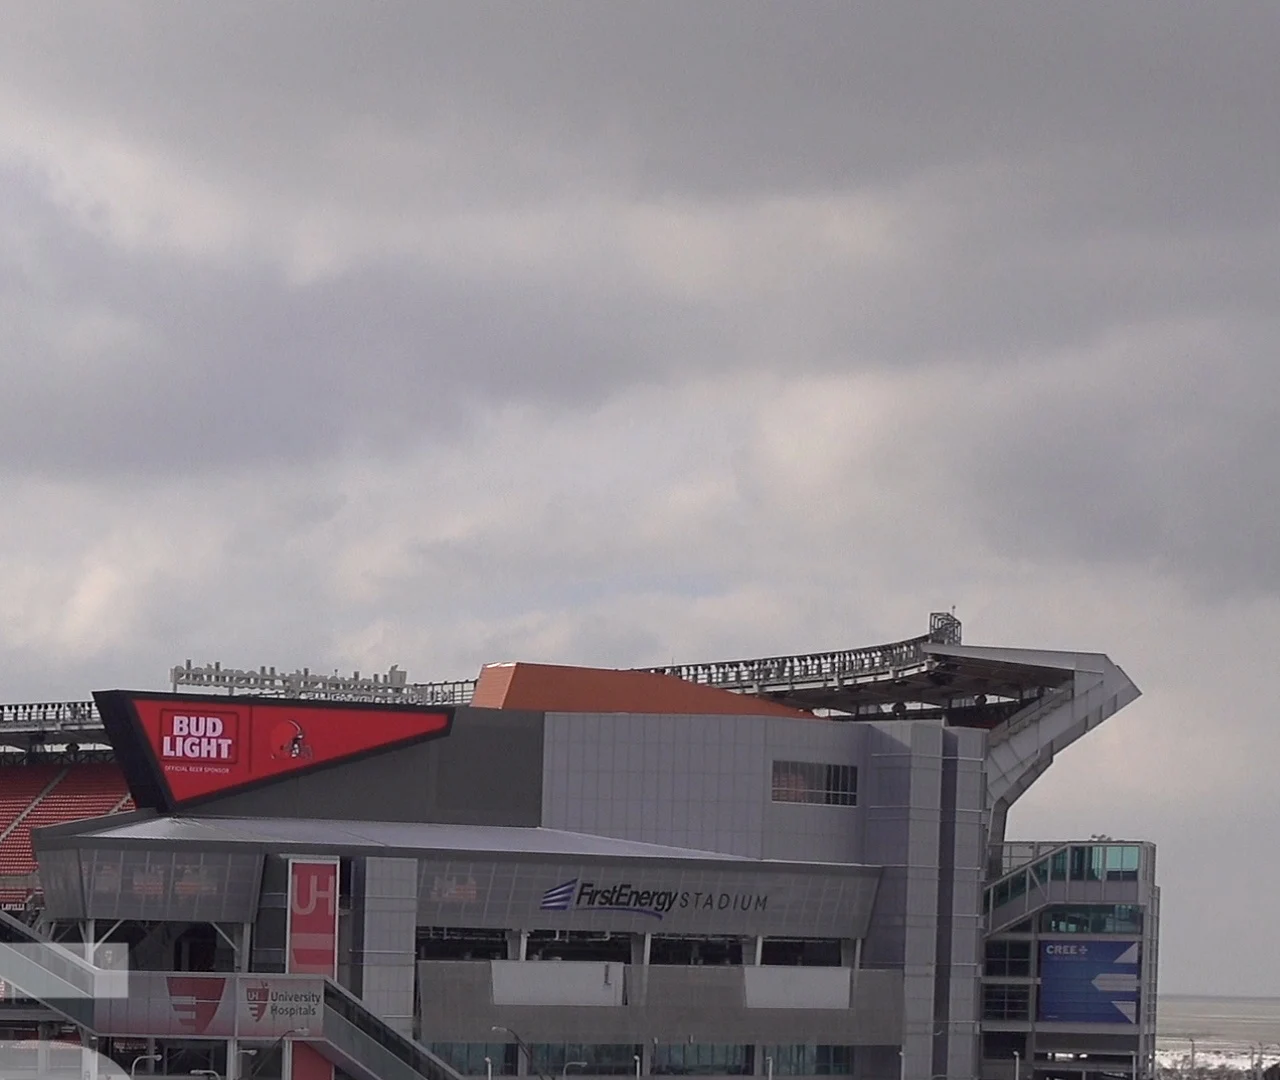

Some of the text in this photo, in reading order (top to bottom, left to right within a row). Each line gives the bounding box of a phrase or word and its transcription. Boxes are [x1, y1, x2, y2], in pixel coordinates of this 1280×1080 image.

[173, 716, 223, 737] BUD
[163, 736, 232, 759] LIGHT
[291, 874, 335, 916] UH
[576, 883, 768, 912] FirstEnergy STADIUM
[1046, 945, 1078, 955] CREE
[270, 991, 321, 1004] University
[270, 1004, 317, 1018] Hospitals
